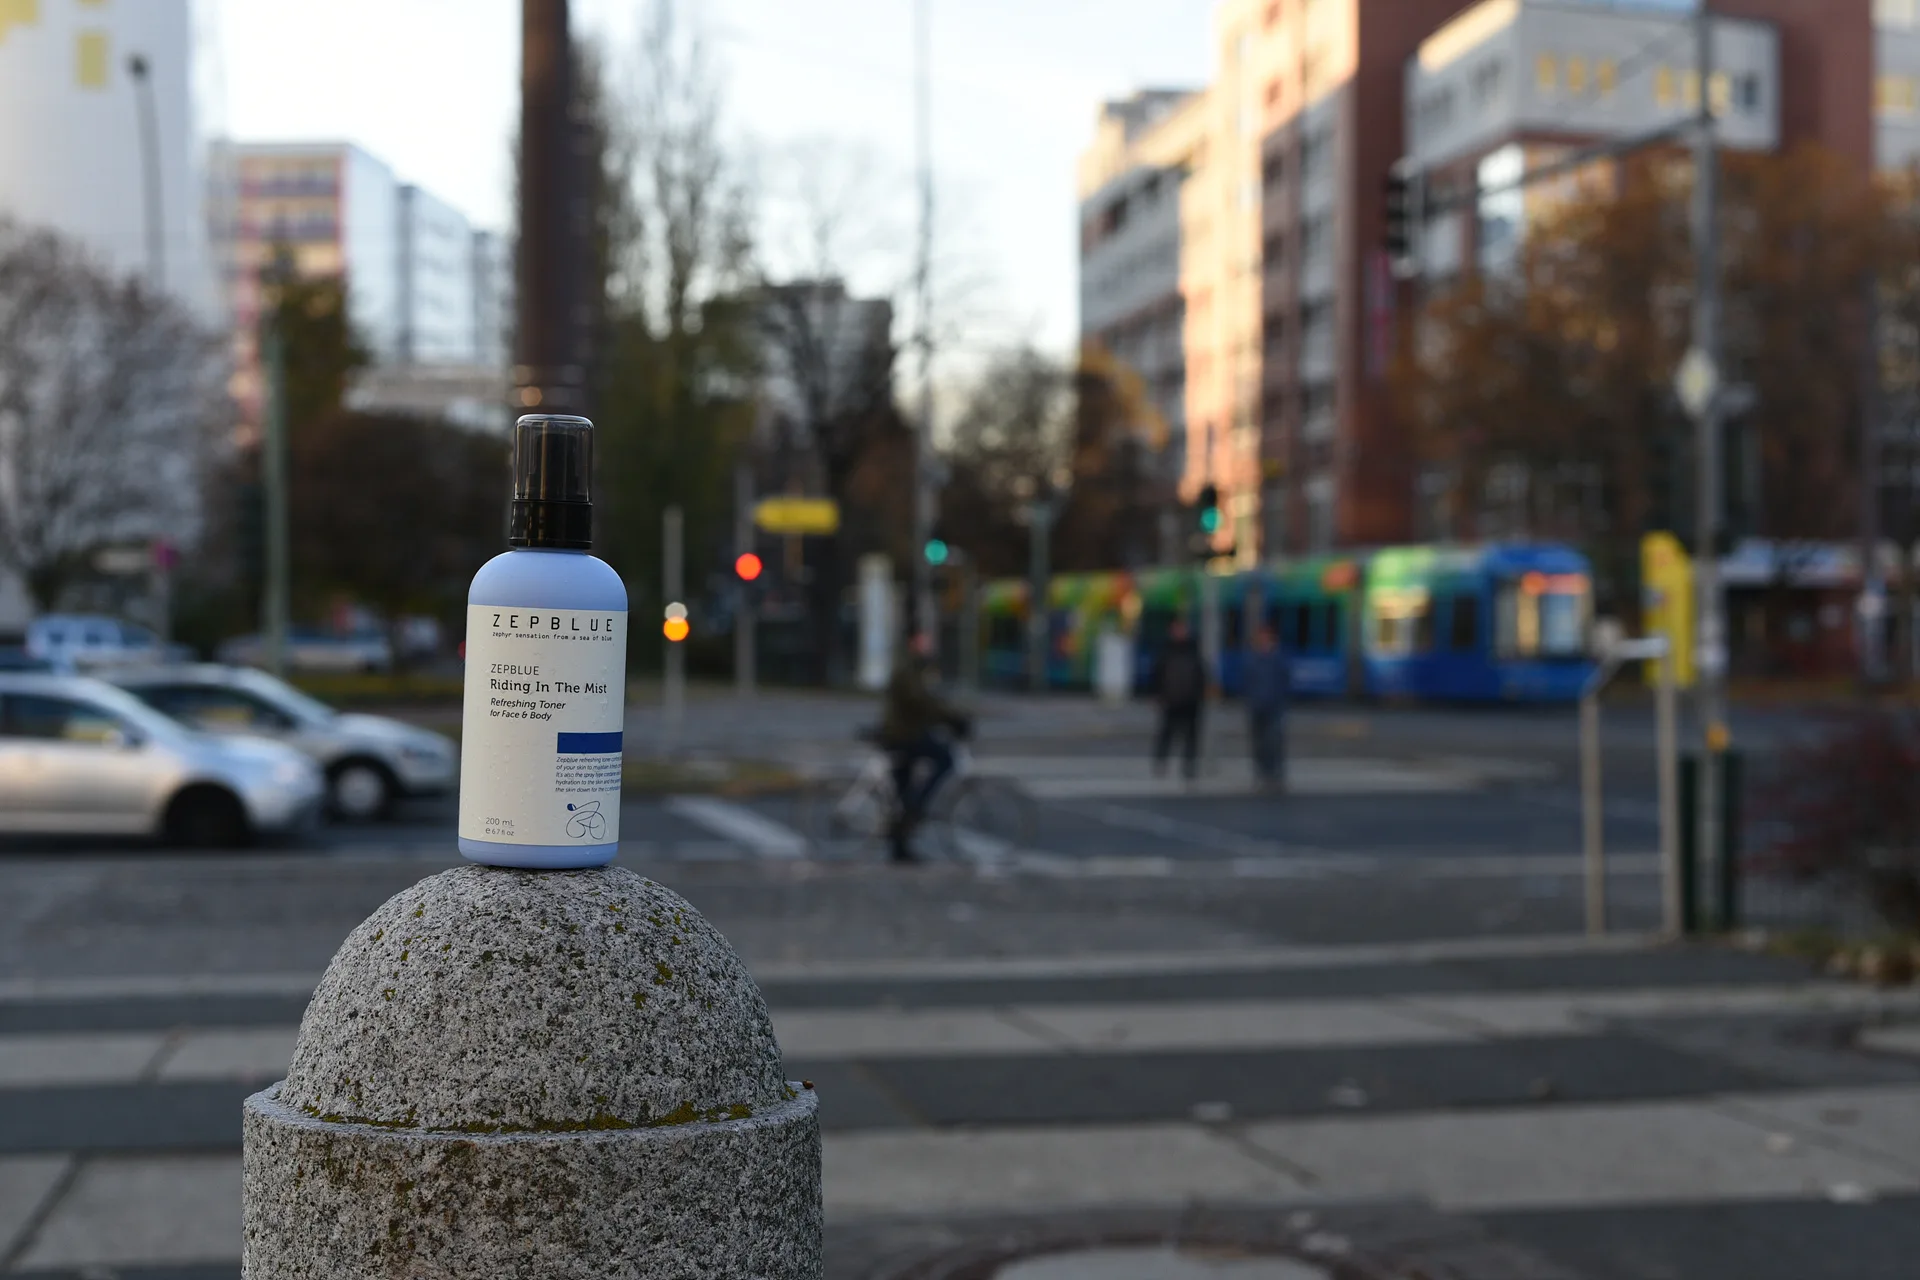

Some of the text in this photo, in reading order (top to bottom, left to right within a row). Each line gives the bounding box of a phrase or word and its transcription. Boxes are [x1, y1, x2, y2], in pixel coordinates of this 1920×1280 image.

[492, 613, 613, 632] ZEPBLUE
[515, 632, 550, 640] sensation
[490, 663, 540, 676] ZEPBLUE
[490, 679, 607, 694] Riding In The Mist
[490, 697, 566, 710] Refreshing Toner
[490, 709, 552, 721] for Face & Body
[486, 818, 515, 827] 200 mL
